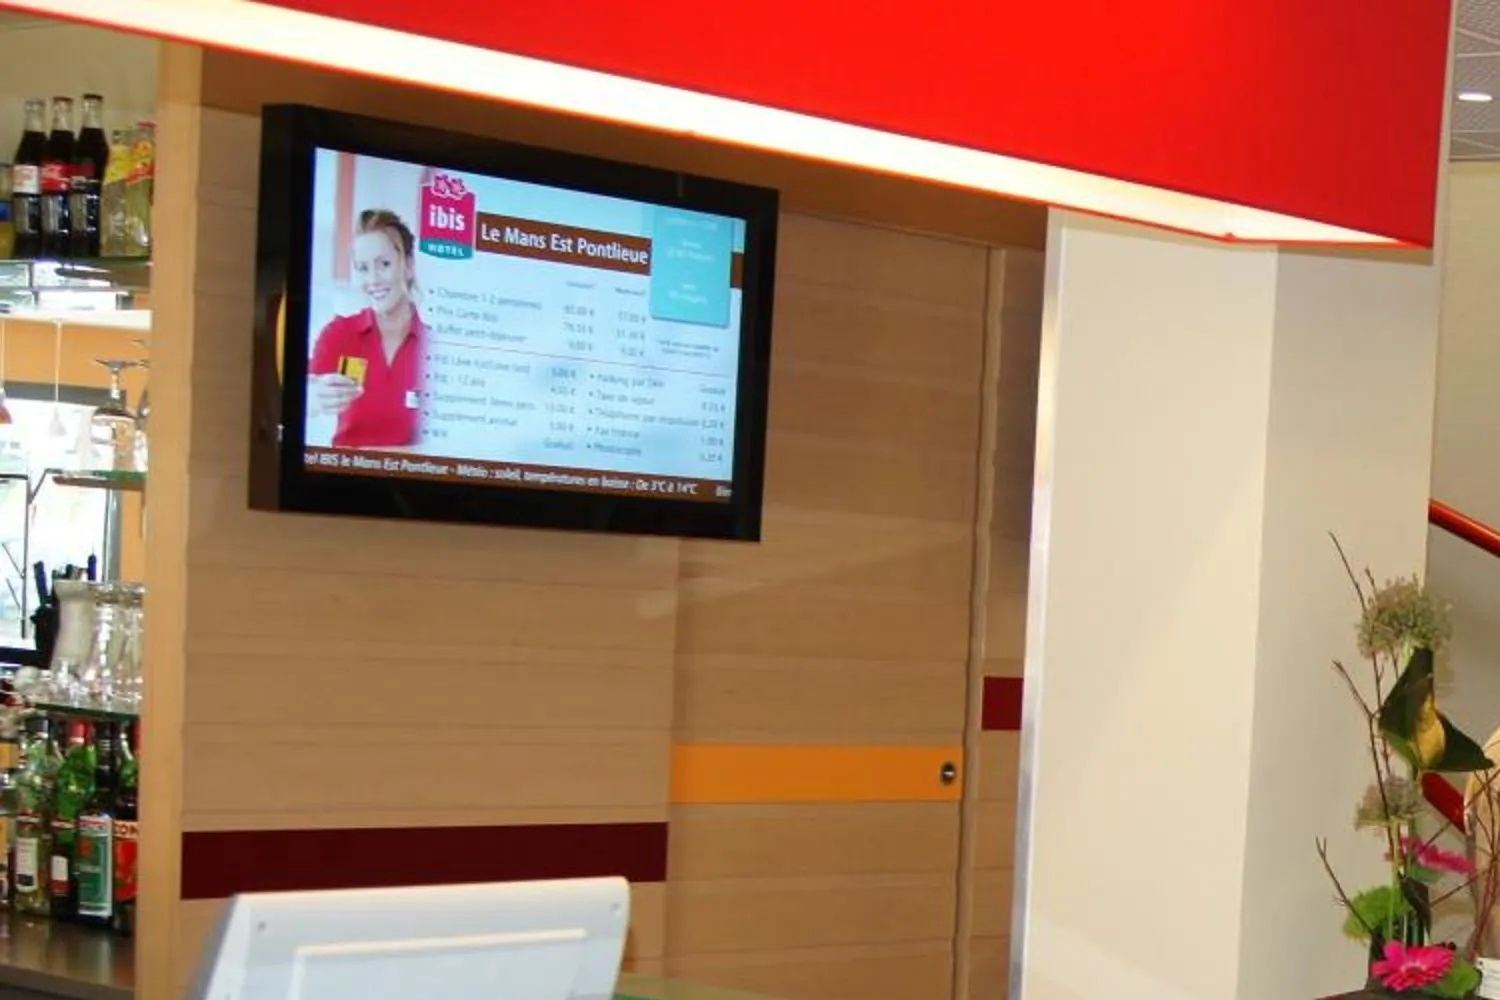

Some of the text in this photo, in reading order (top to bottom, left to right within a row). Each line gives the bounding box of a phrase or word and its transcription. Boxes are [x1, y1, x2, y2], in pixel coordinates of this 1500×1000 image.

[429, 204, 466, 231] ibis
[481, 223, 500, 242] Le
[504, 227, 547, 250] Mans
[551, 233, 573, 253] Est
[577, 238, 649, 265] Pontlieue
[353, 455, 382, 469] Mans
[383, 457, 400, 472] Est
